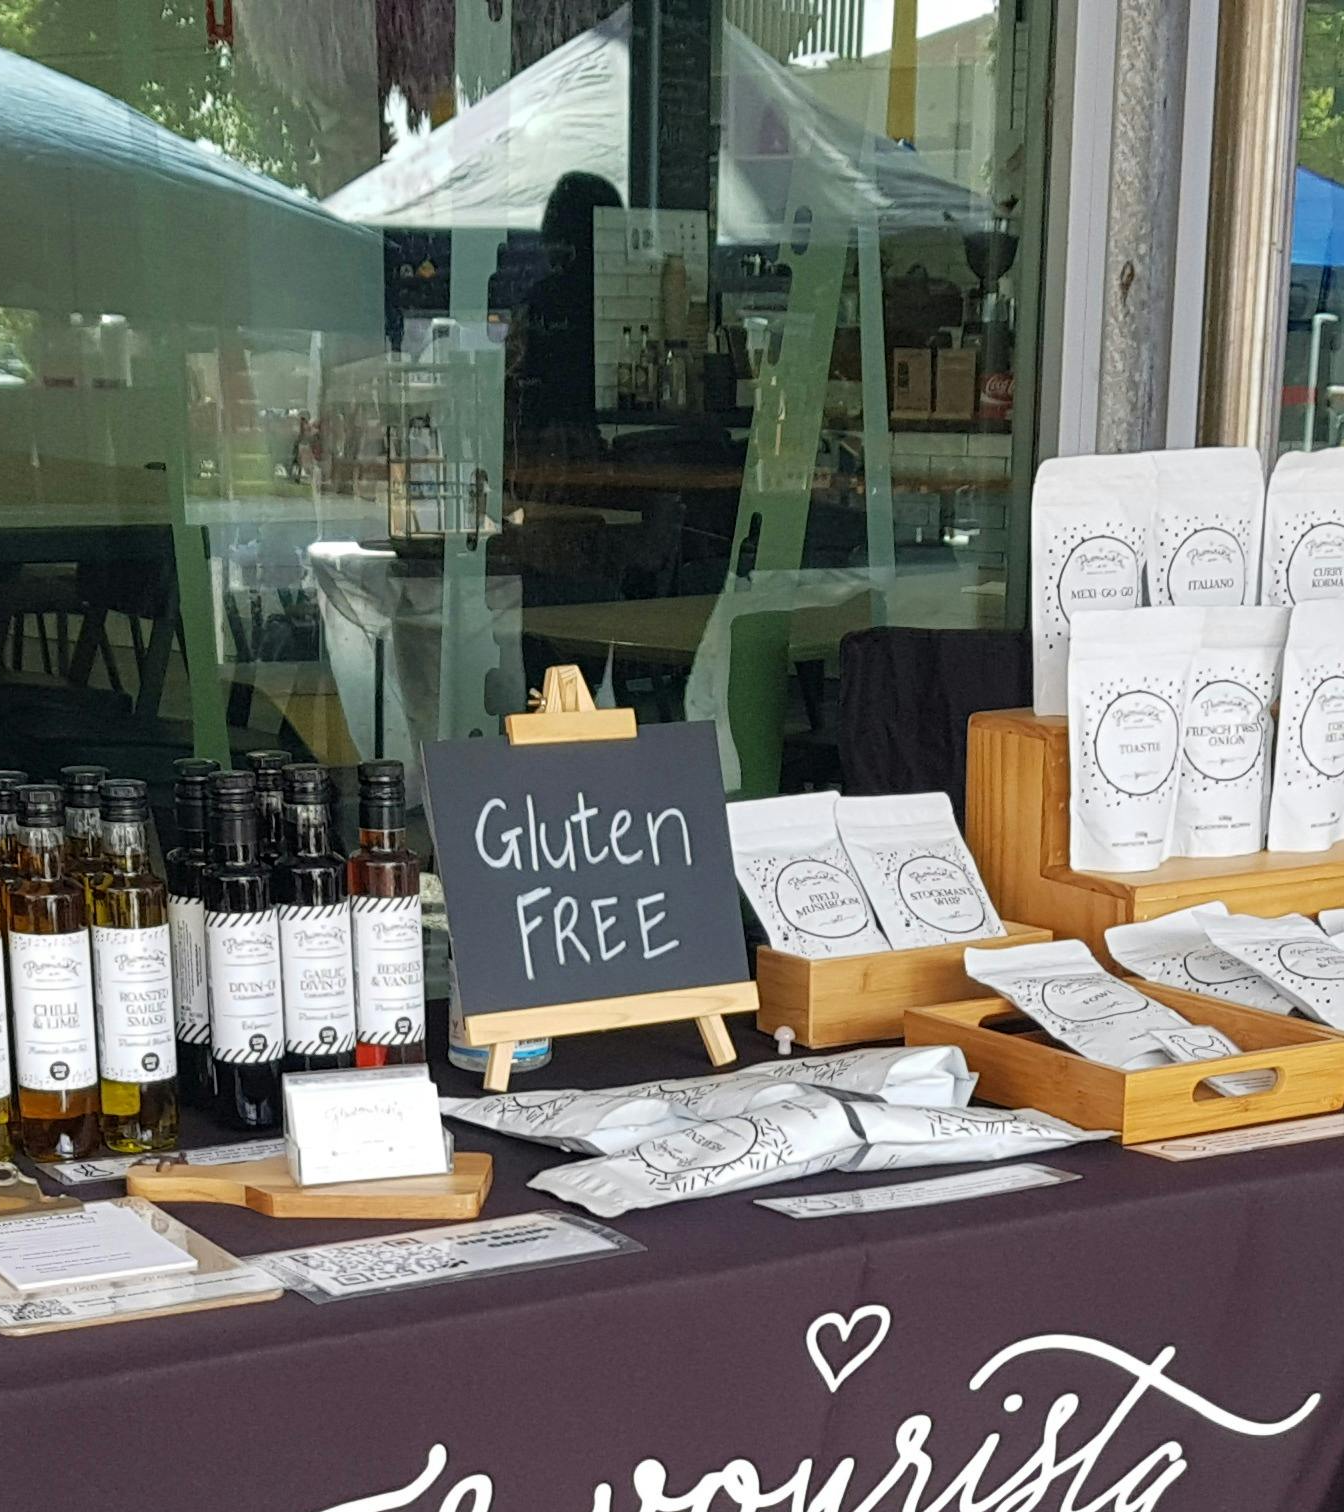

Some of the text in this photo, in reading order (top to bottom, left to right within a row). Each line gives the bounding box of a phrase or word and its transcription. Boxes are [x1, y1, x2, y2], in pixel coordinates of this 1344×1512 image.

[1313, 567, 1343, 577] CURRY
[1188, 578, 1234, 590] ITALIANO
[1312, 577, 1344, 588] KORMA
[1185, 726, 1232, 737] FRENCH
[1209, 735, 1246, 746] ONION
[475, 792, 692, 871] Gluten
[795, 897, 861, 918] MUSHROOM
[517, 887, 679, 980] FREE
[371, 977, 379, 987] &
[120, 989, 169, 1002] ROASTED
[33, 1003, 79, 1017] CHILLI
[126, 1002, 167, 1015] GARLIC
[33, 1016, 81, 1029] & LIME
